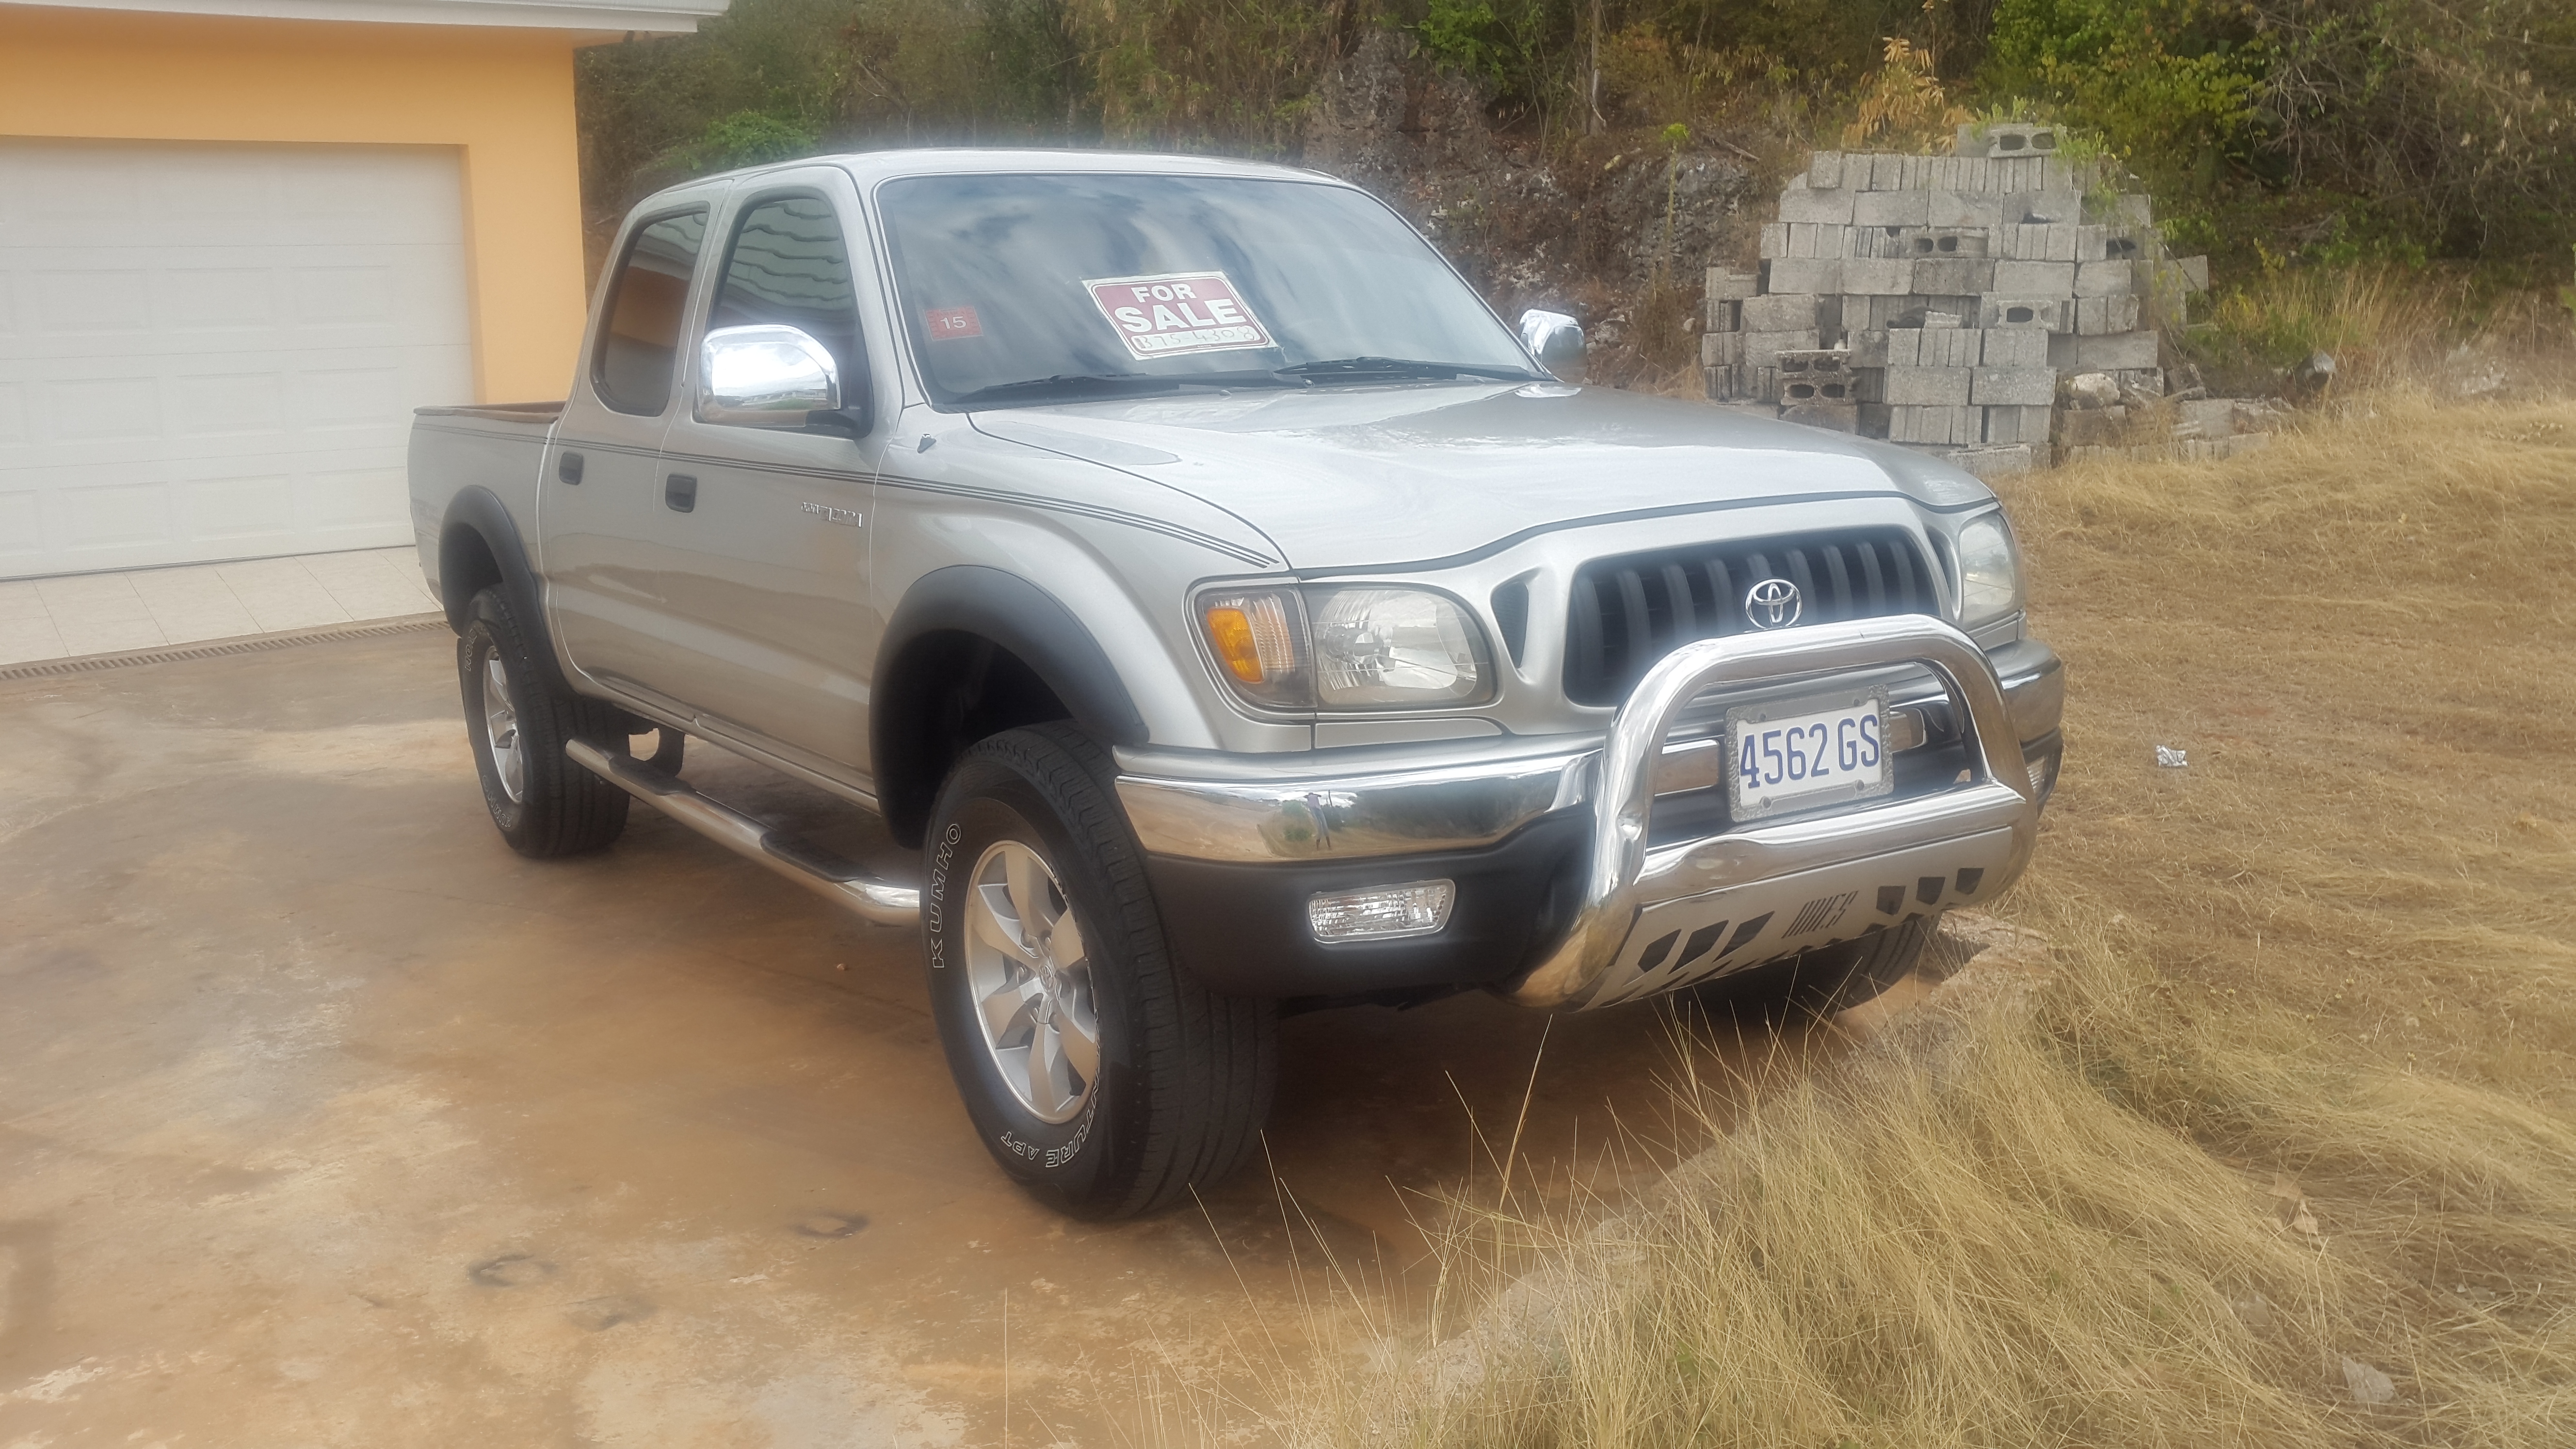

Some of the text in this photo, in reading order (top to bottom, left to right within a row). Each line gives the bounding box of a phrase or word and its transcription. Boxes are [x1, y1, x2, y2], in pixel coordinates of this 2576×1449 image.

[1130, 283, 1197, 303] FOR
[940, 316, 966, 329] 15
[1114, 298, 1247, 332] SALE
[1739, 714, 1879, 789] 4562 GS
[930, 823, 961, 968] KUMHO
[1000, 1131, 1040, 1160] APT
